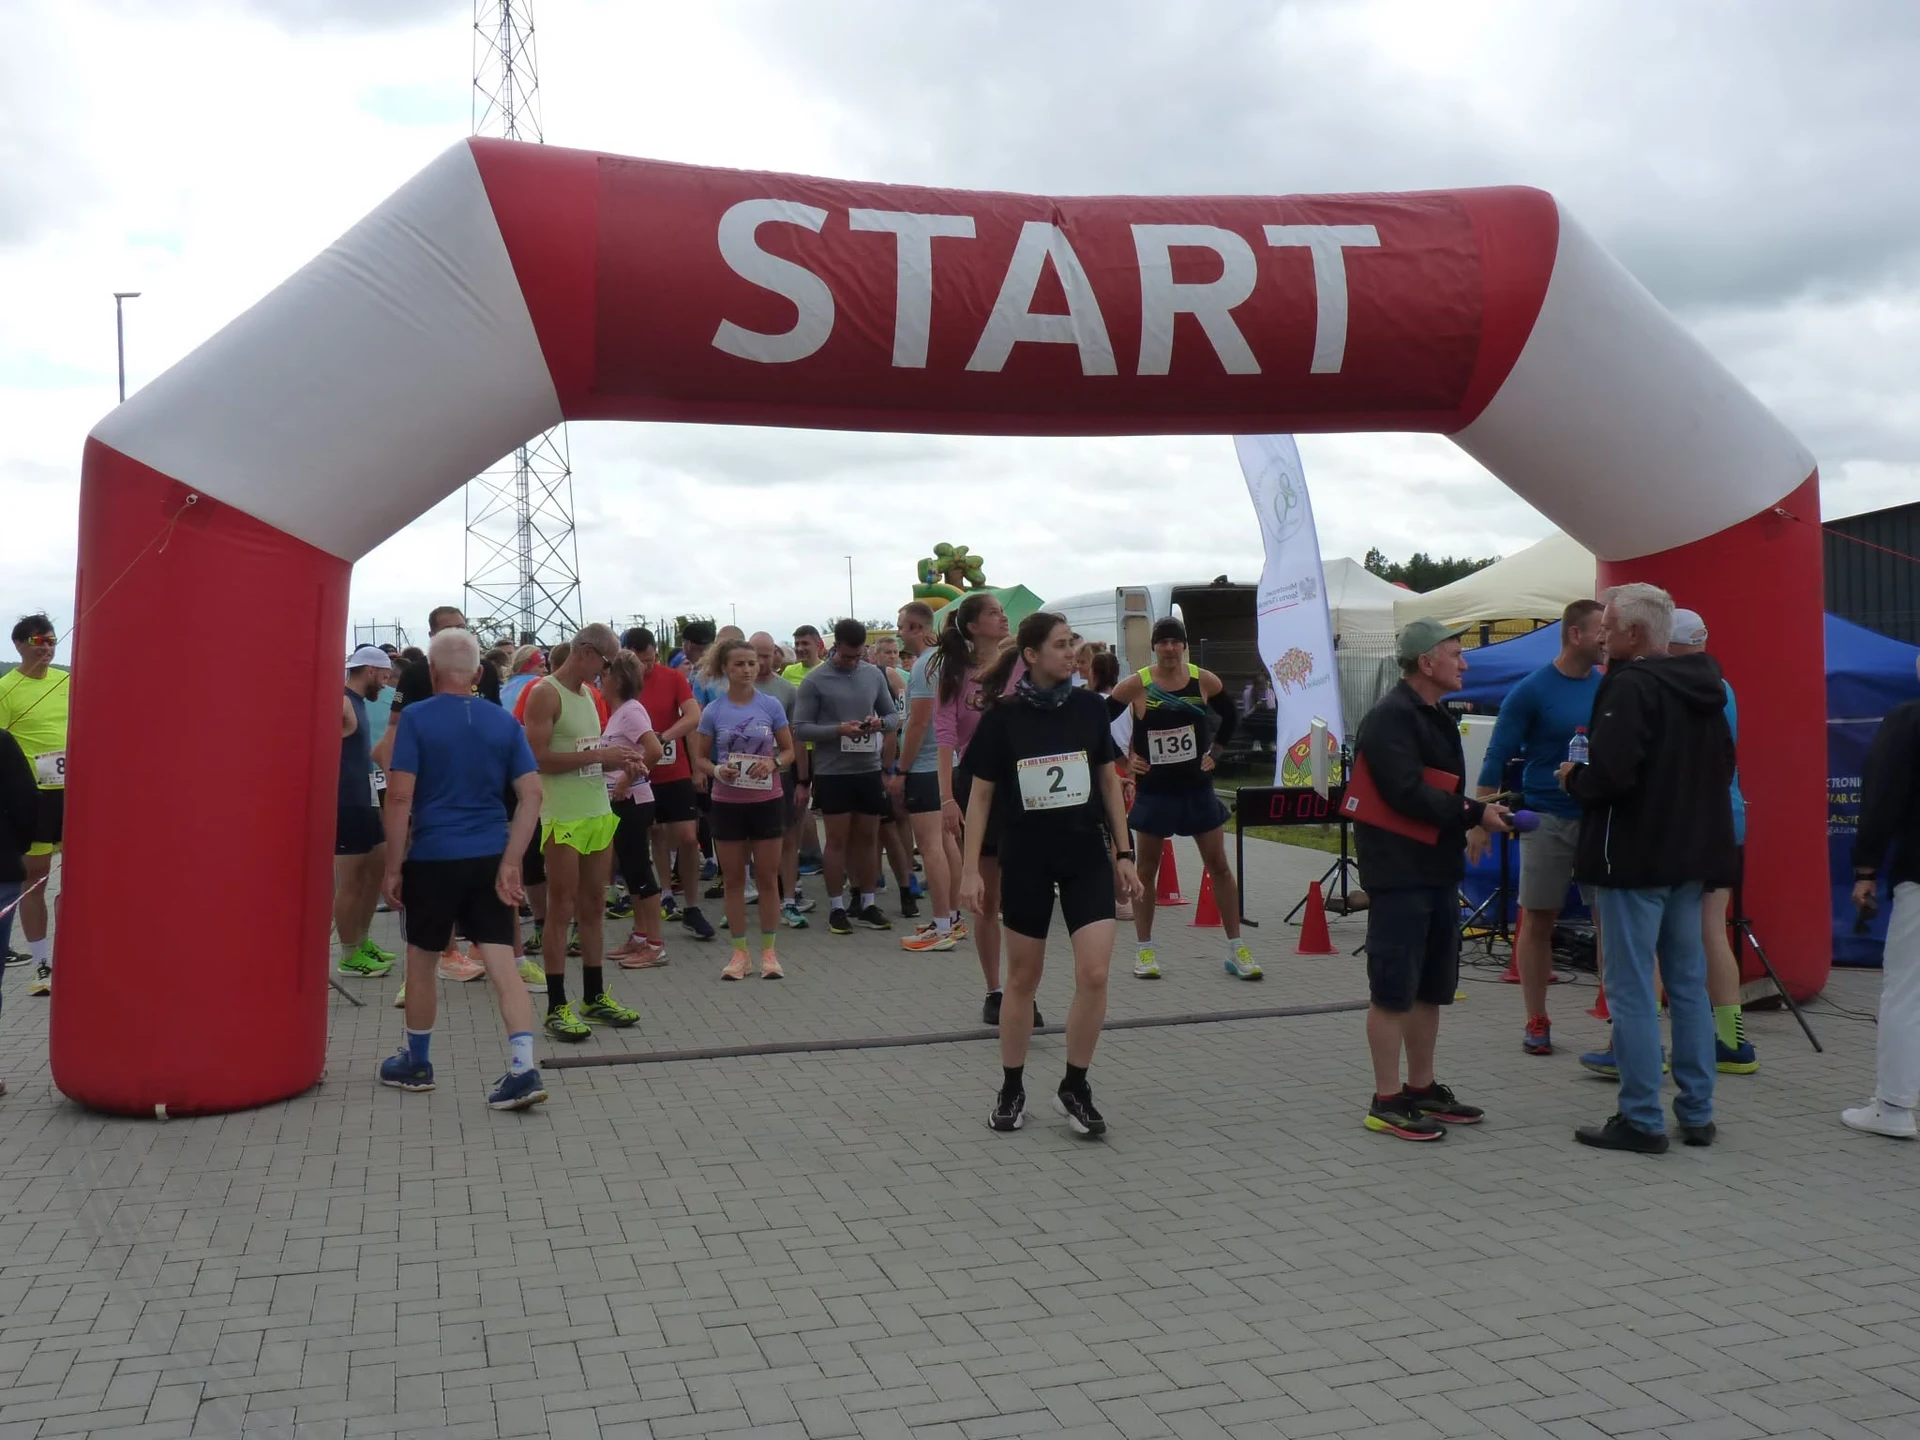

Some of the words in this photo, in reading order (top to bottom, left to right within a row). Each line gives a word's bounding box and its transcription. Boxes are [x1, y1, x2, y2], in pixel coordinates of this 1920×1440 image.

[711, 198, 1381, 376] START
[1153, 733, 1193, 755] 136
[375, 771, 385, 783] 5
[1046, 765, 1067, 793] 2
[1826, 776, 1863, 788] TRONI
